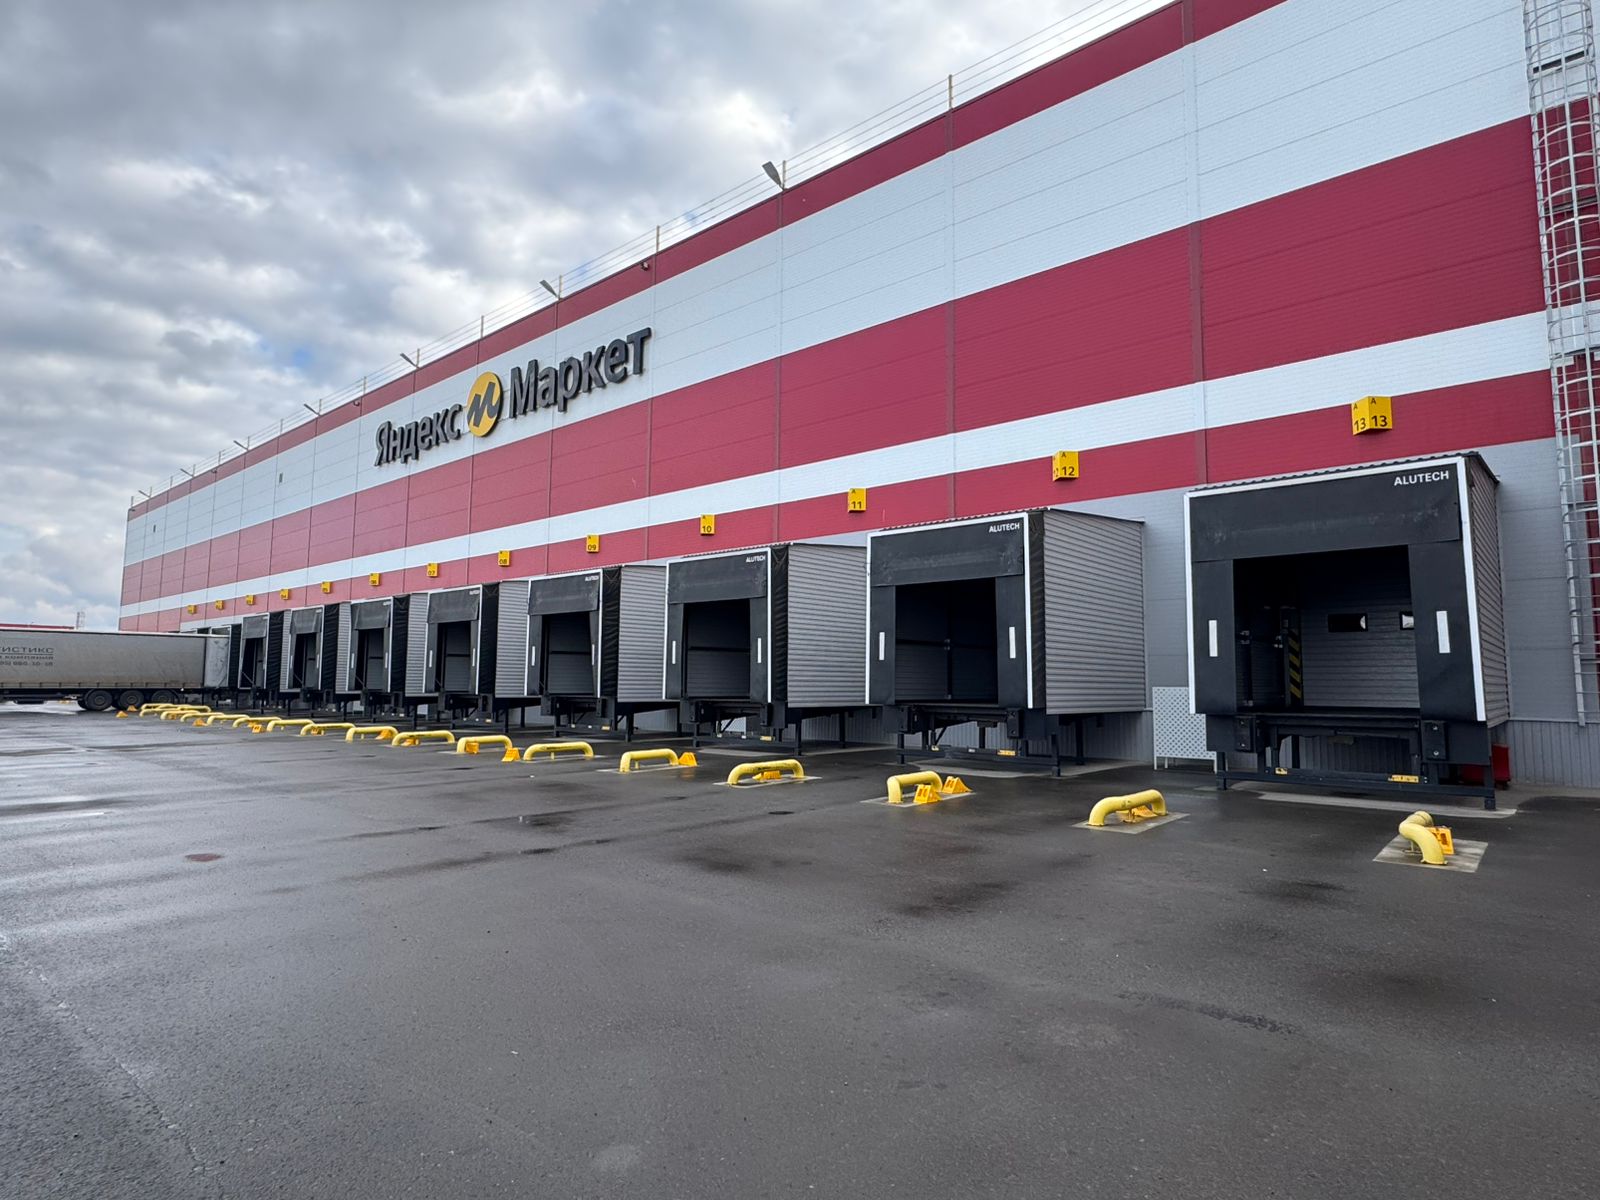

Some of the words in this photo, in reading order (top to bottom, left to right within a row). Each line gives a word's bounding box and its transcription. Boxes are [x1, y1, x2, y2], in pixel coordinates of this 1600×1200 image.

[509, 327, 652, 419] Маркет
[1354, 417, 1367, 431] 13
[1371, 415, 1388, 427] 13
[374, 403, 463, 466] Яндекс
[1061, 466, 1075, 476] 12
[1394, 470, 1449, 486] ALUTECH
[851, 501, 862, 509] 11
[702, 525, 712, 533] 10
[989, 522, 1020, 533] ALUTECH
